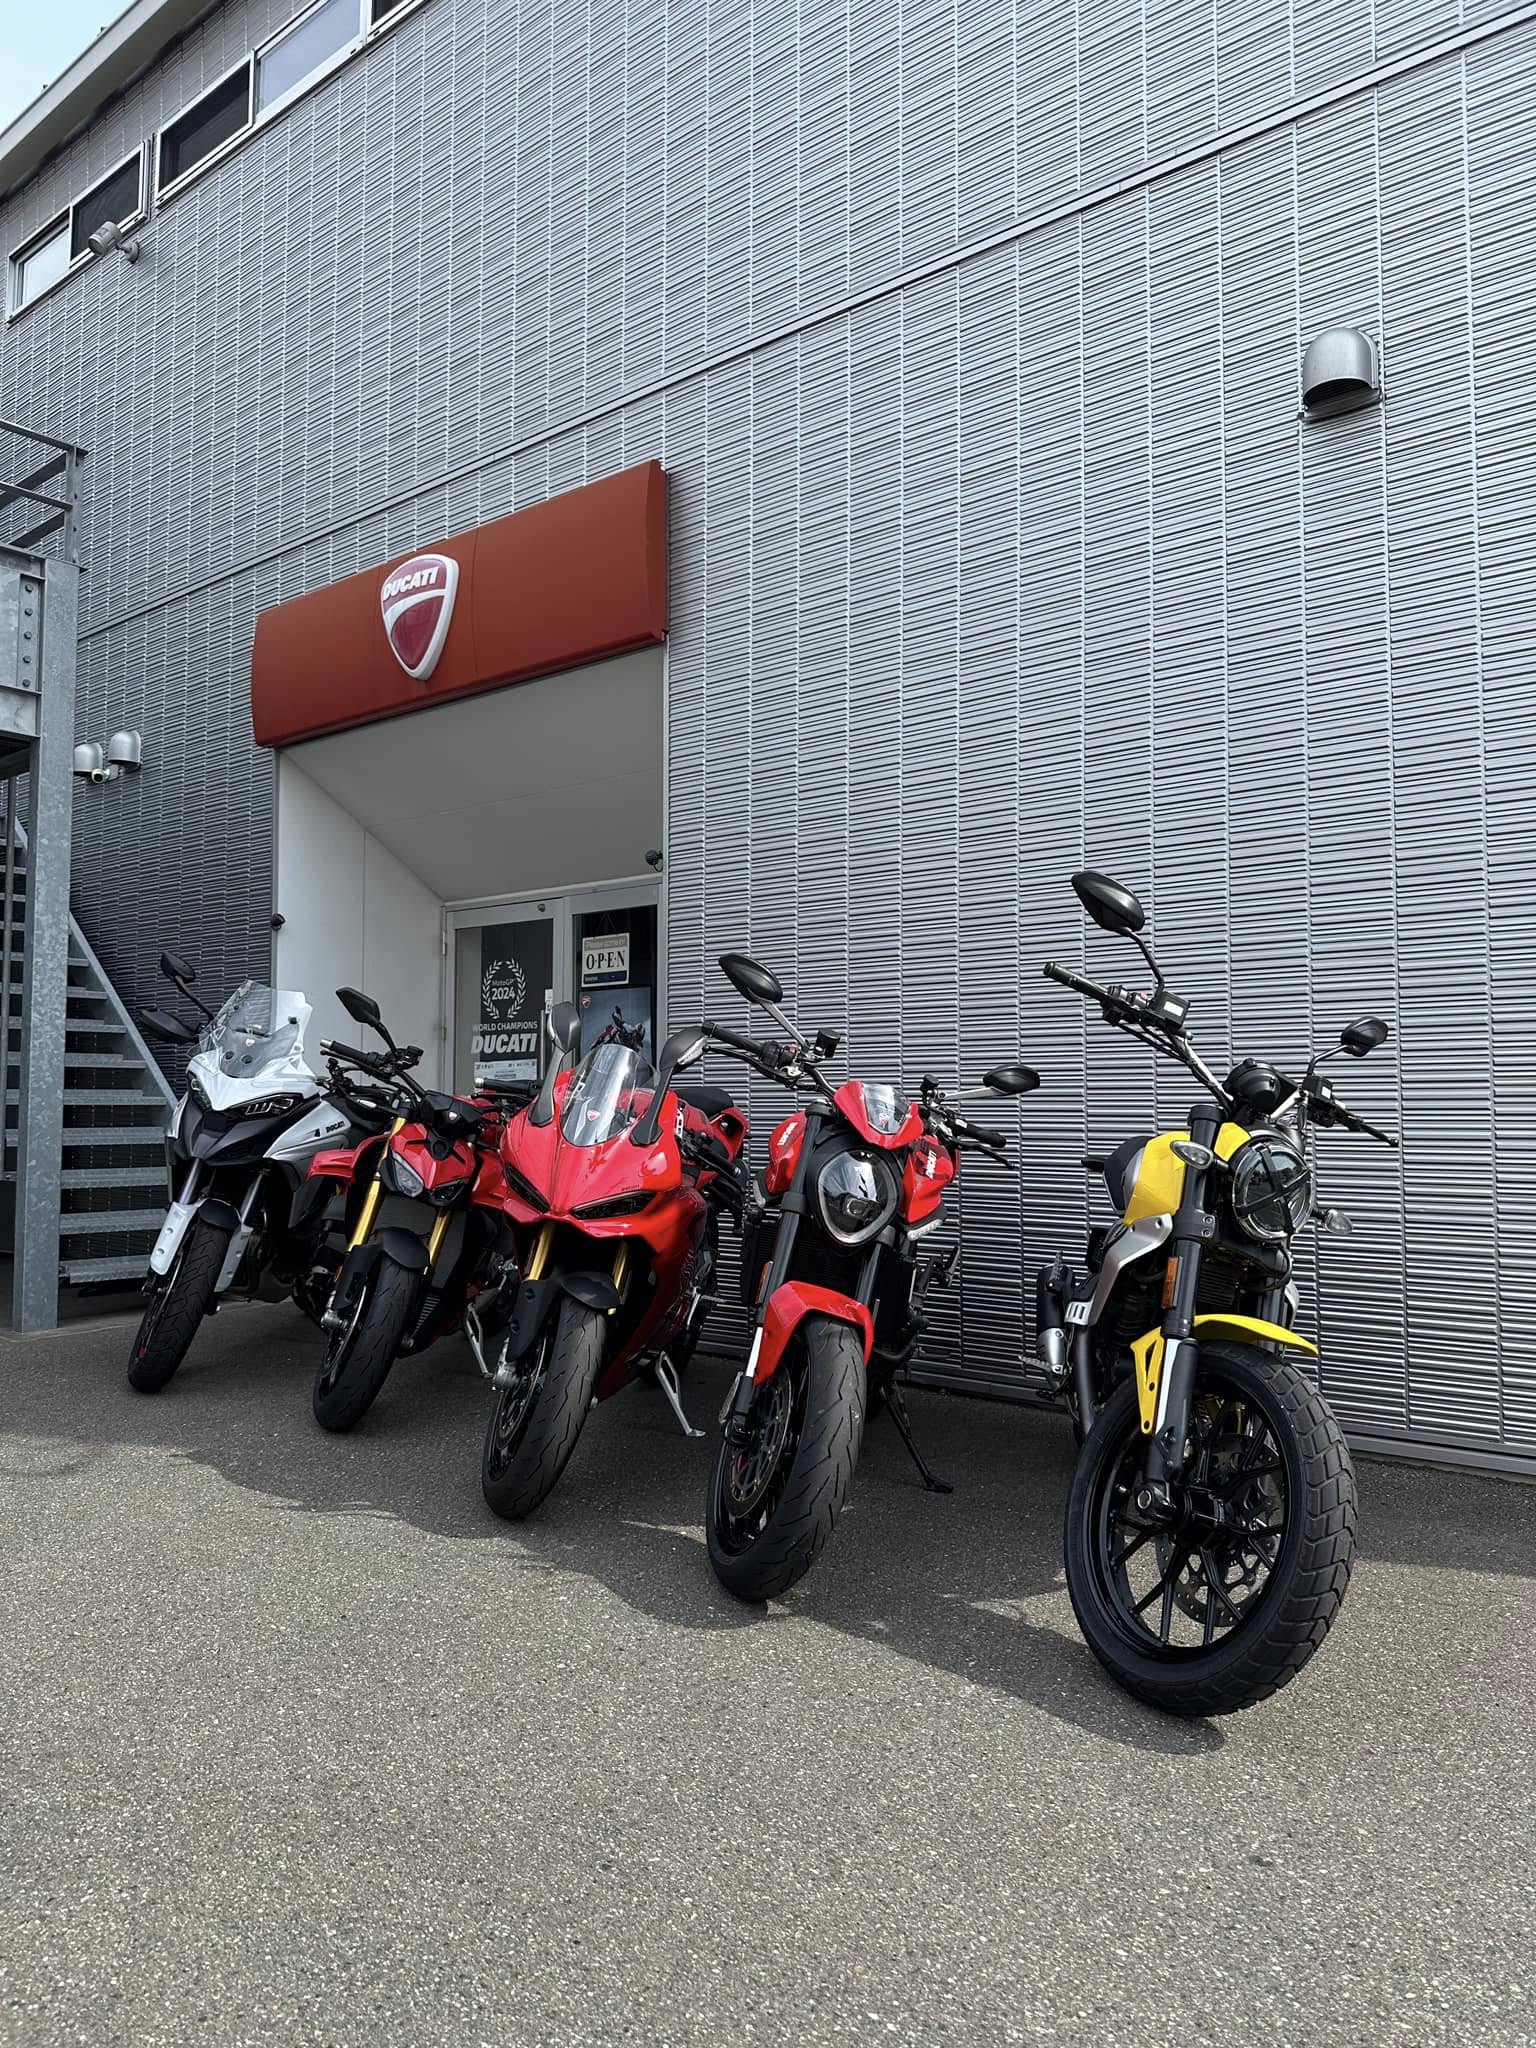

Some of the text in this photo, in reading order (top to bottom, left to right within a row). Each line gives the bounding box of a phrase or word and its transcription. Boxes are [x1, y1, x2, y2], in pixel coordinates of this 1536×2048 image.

[383, 567, 439, 601] DUCATI
[491, 987, 515, 1000] 2024
[472, 1020, 538, 1032] WORLD CHAMPIONS
[471, 1033, 537, 1054] DUCATI
